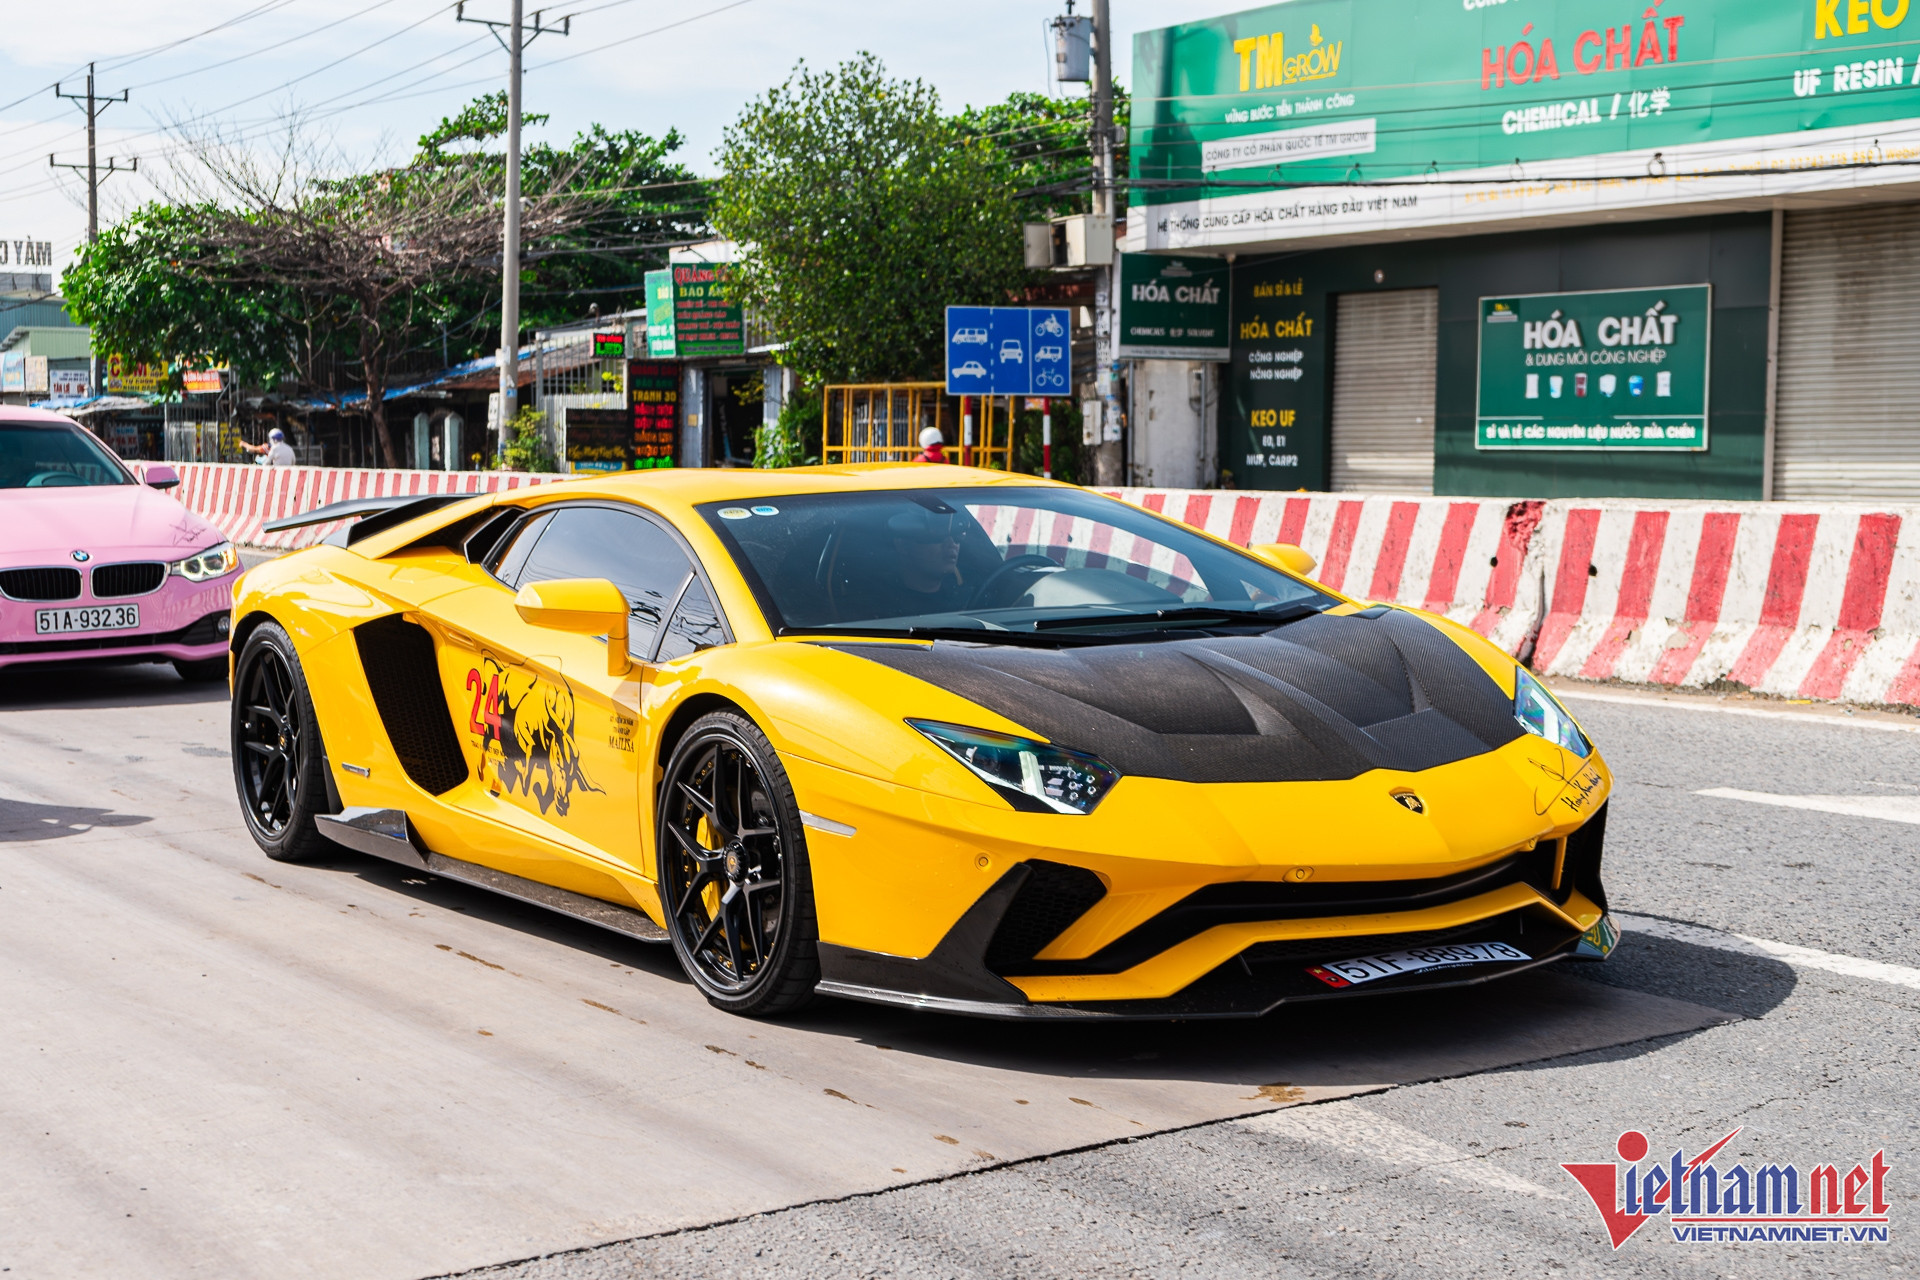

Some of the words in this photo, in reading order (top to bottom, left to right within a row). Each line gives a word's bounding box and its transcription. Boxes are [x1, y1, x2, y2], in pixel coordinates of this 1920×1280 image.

[1481, 22, 1560, 91] HÓA
[1573, 0, 1685, 74] CHẤT
[1233, 32, 1284, 92] TM
[1283, 40, 1343, 80] GROW
[1793, 68, 1822, 97] UF
[1833, 56, 1904, 92] RESIN
[1501, 98, 1602, 135] CHEMICAL
[1392, 195, 1418, 209] NAM
[1131, 279, 1170, 302] HÓA
[1175, 277, 1221, 304] CHẤT
[1254, 281, 1273, 298] BÁN
[1240, 315, 1269, 340] HÓA
[1275, 311, 1314, 338] CHẤT
[1523, 309, 1584, 350] HÓA
[1597, 300, 1679, 347] CHẤT
[1248, 349, 1273, 364] CÔNG
[1566, 349, 1588, 365] MÔI
[1590, 347, 1626, 365] CÔNG
[1250, 410, 1277, 427] KEO
[1279, 409, 1296, 427] UF
[39, 606, 137, 632] 51A-932.36
[466, 668, 503, 741] 24
[1332, 942, 1522, 980] 51F-889.78
